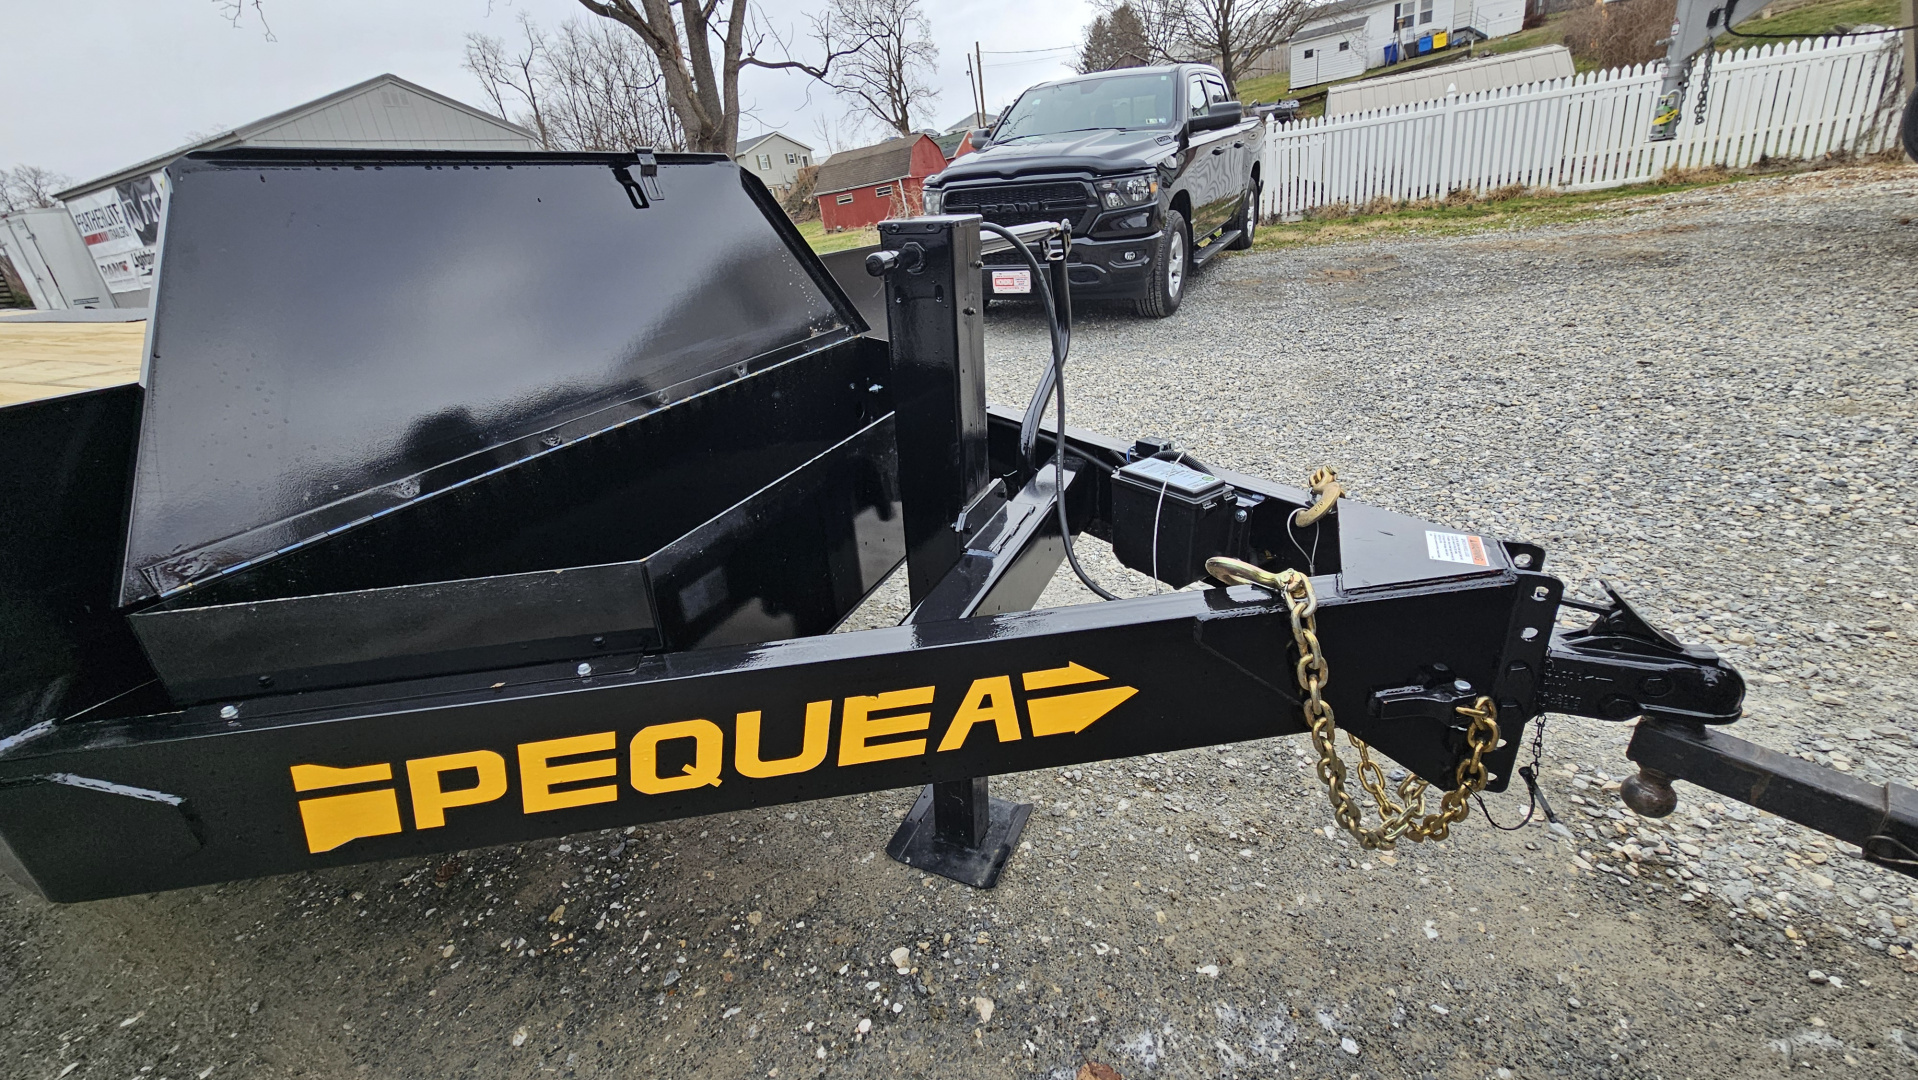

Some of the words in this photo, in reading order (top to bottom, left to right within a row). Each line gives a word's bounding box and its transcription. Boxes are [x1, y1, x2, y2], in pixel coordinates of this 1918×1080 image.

[75, 203, 123, 233] FEATHERLITE
[980, 202, 1040, 213] RAM
[406, 675, 1021, 830] PEQUEA
